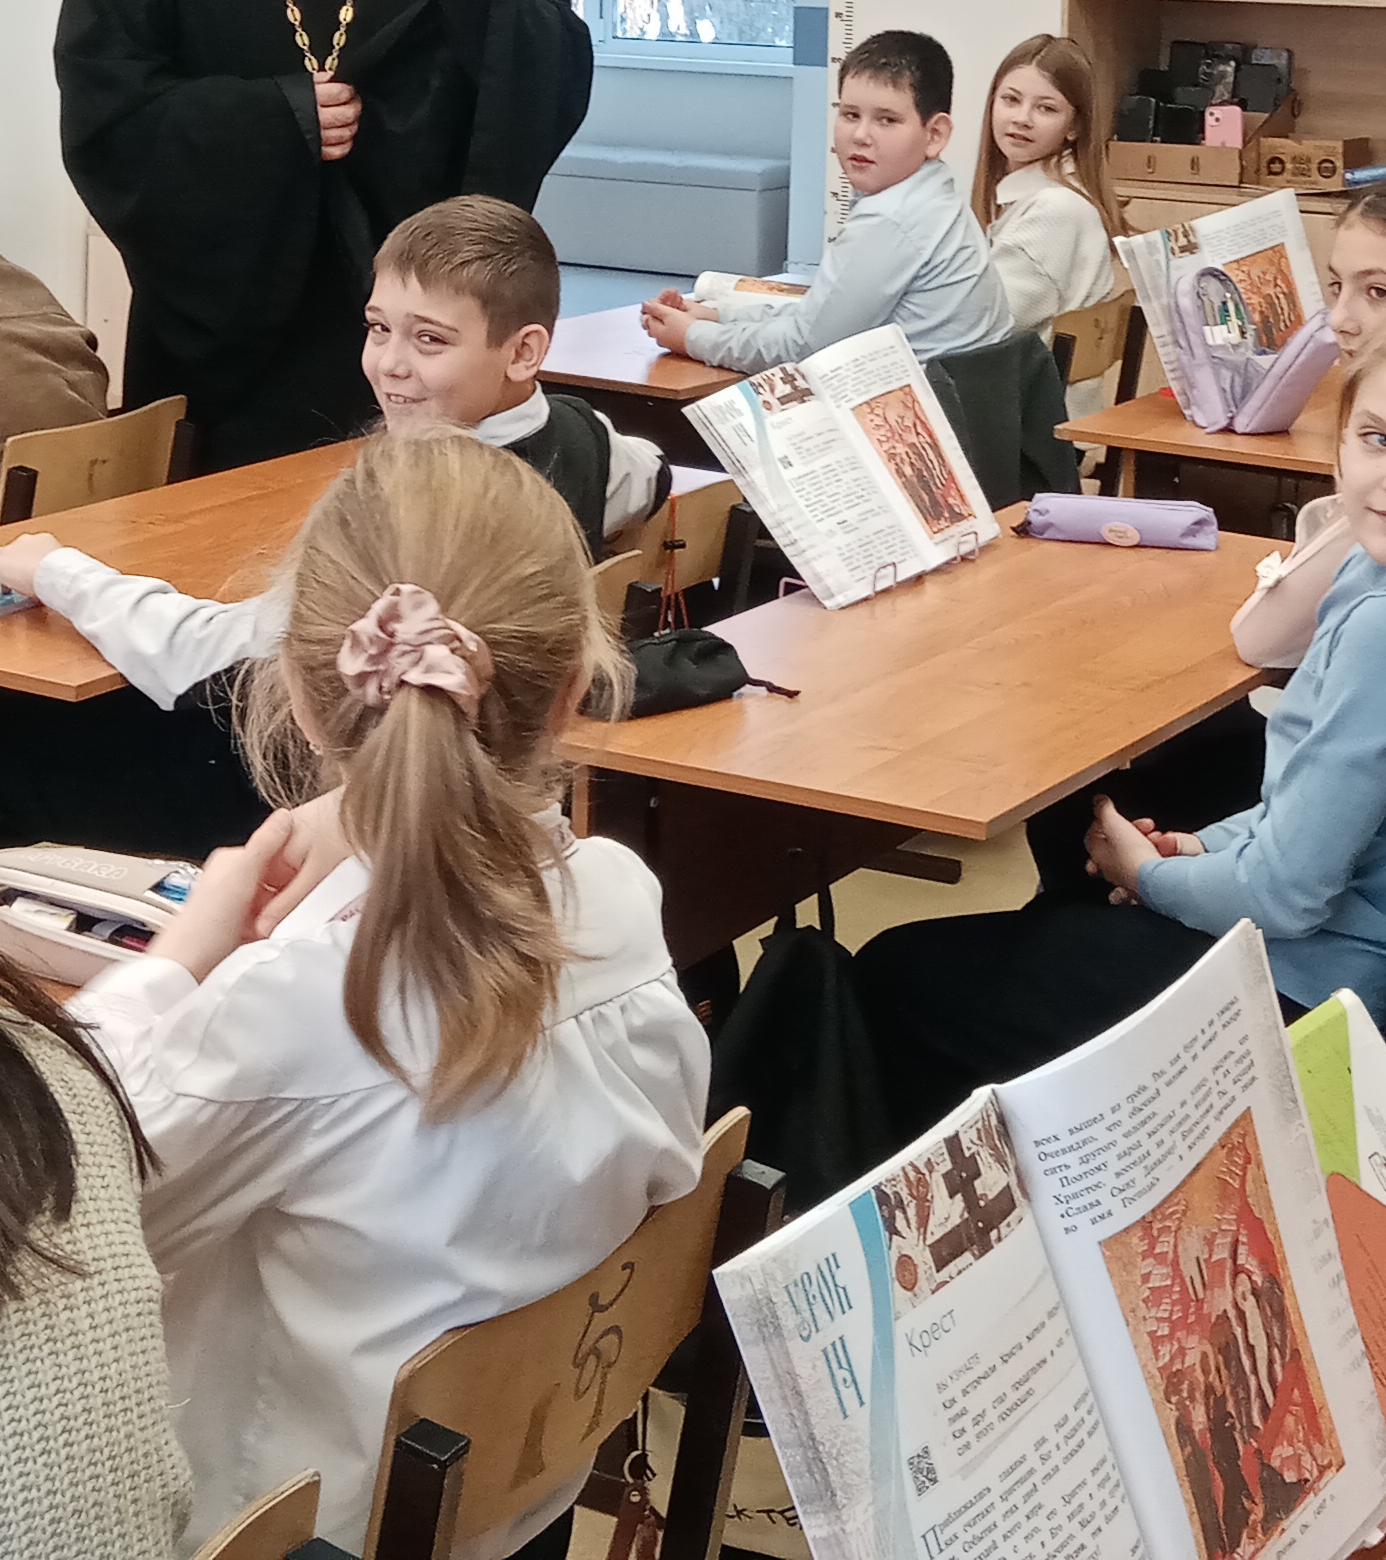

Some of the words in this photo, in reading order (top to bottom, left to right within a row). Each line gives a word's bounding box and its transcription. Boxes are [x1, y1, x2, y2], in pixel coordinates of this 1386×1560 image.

[1068, 1113, 1106, 1137] вышел
[1037, 1135, 1099, 1162] Очевидно,
[1059, 1159, 1109, 1189] Поэтому
[1064, 1223, 1078, 1235] во
[1090, 1211, 1114, 1227] имя
[783, 1252, 853, 1342] УРОК
[905, 1309, 957, 1357] Крест
